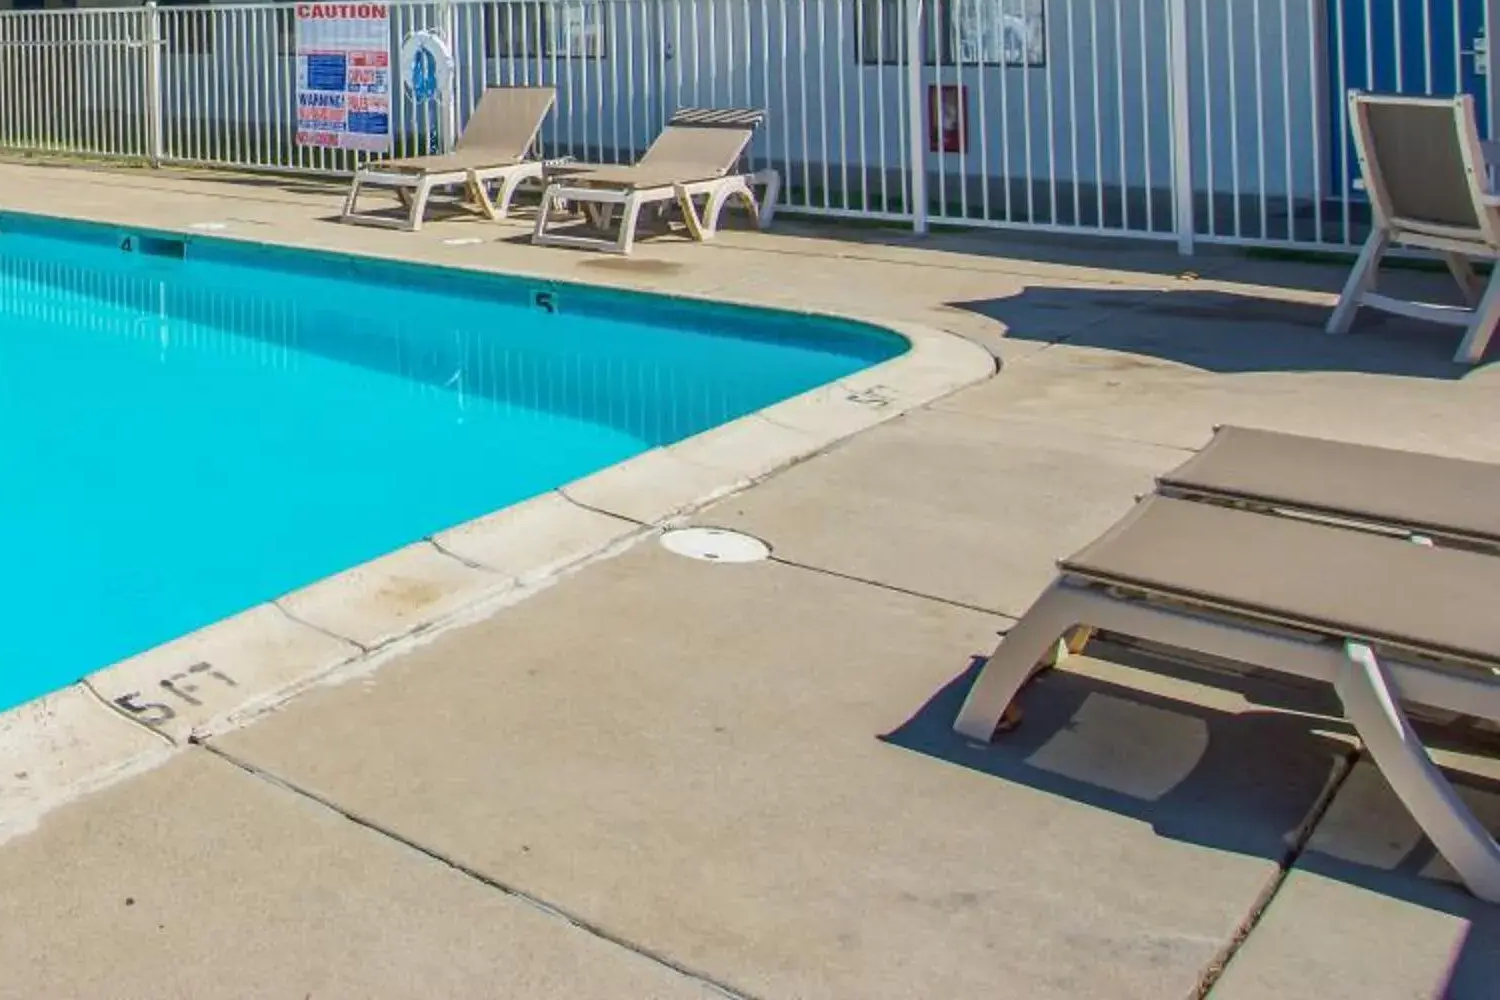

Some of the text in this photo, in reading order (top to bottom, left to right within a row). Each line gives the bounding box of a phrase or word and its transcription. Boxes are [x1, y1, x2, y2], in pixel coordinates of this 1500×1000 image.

[297, 4, 386, 18] CAUTION
[119, 236, 133, 252] 4
[113, 690, 176, 726] 5
